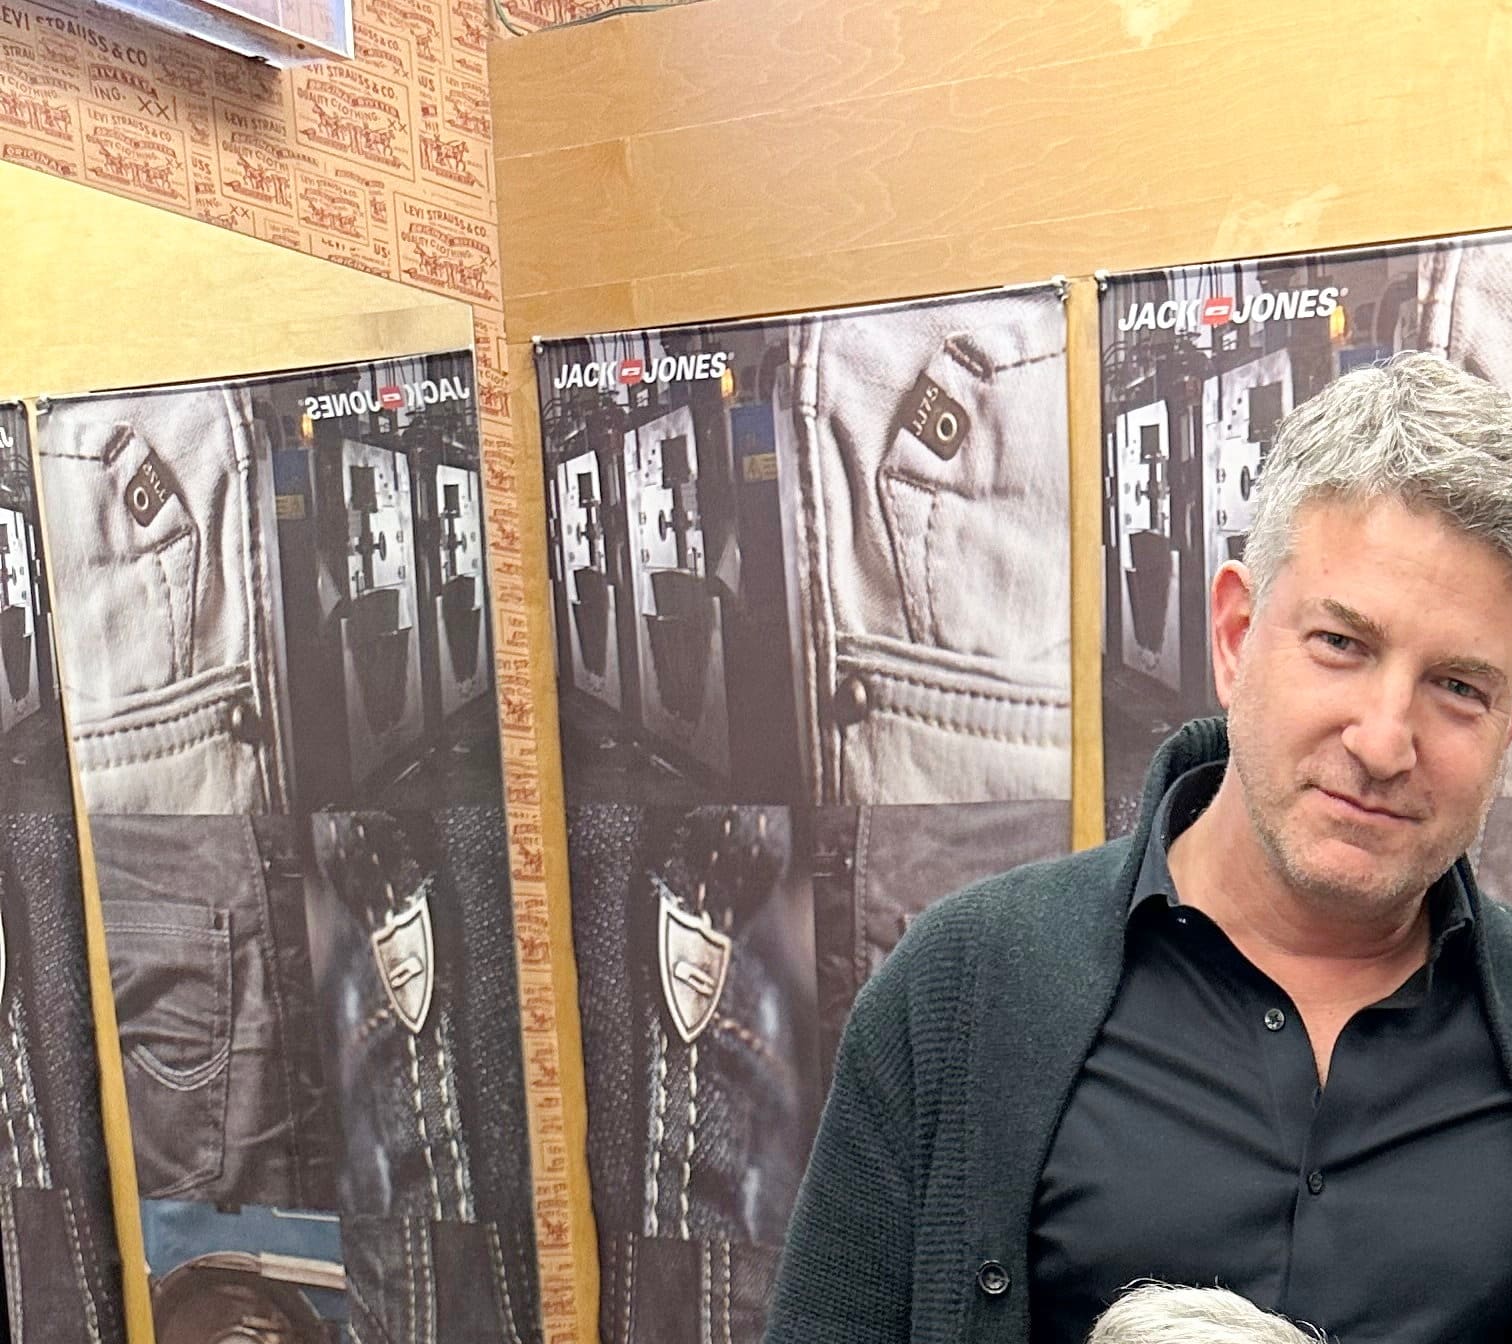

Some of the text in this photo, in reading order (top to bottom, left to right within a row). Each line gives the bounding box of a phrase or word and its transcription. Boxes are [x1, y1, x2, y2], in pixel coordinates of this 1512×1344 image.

[1118, 287, 1340, 331] JACK JONES
[554, 351, 729, 390] JACK JONES
